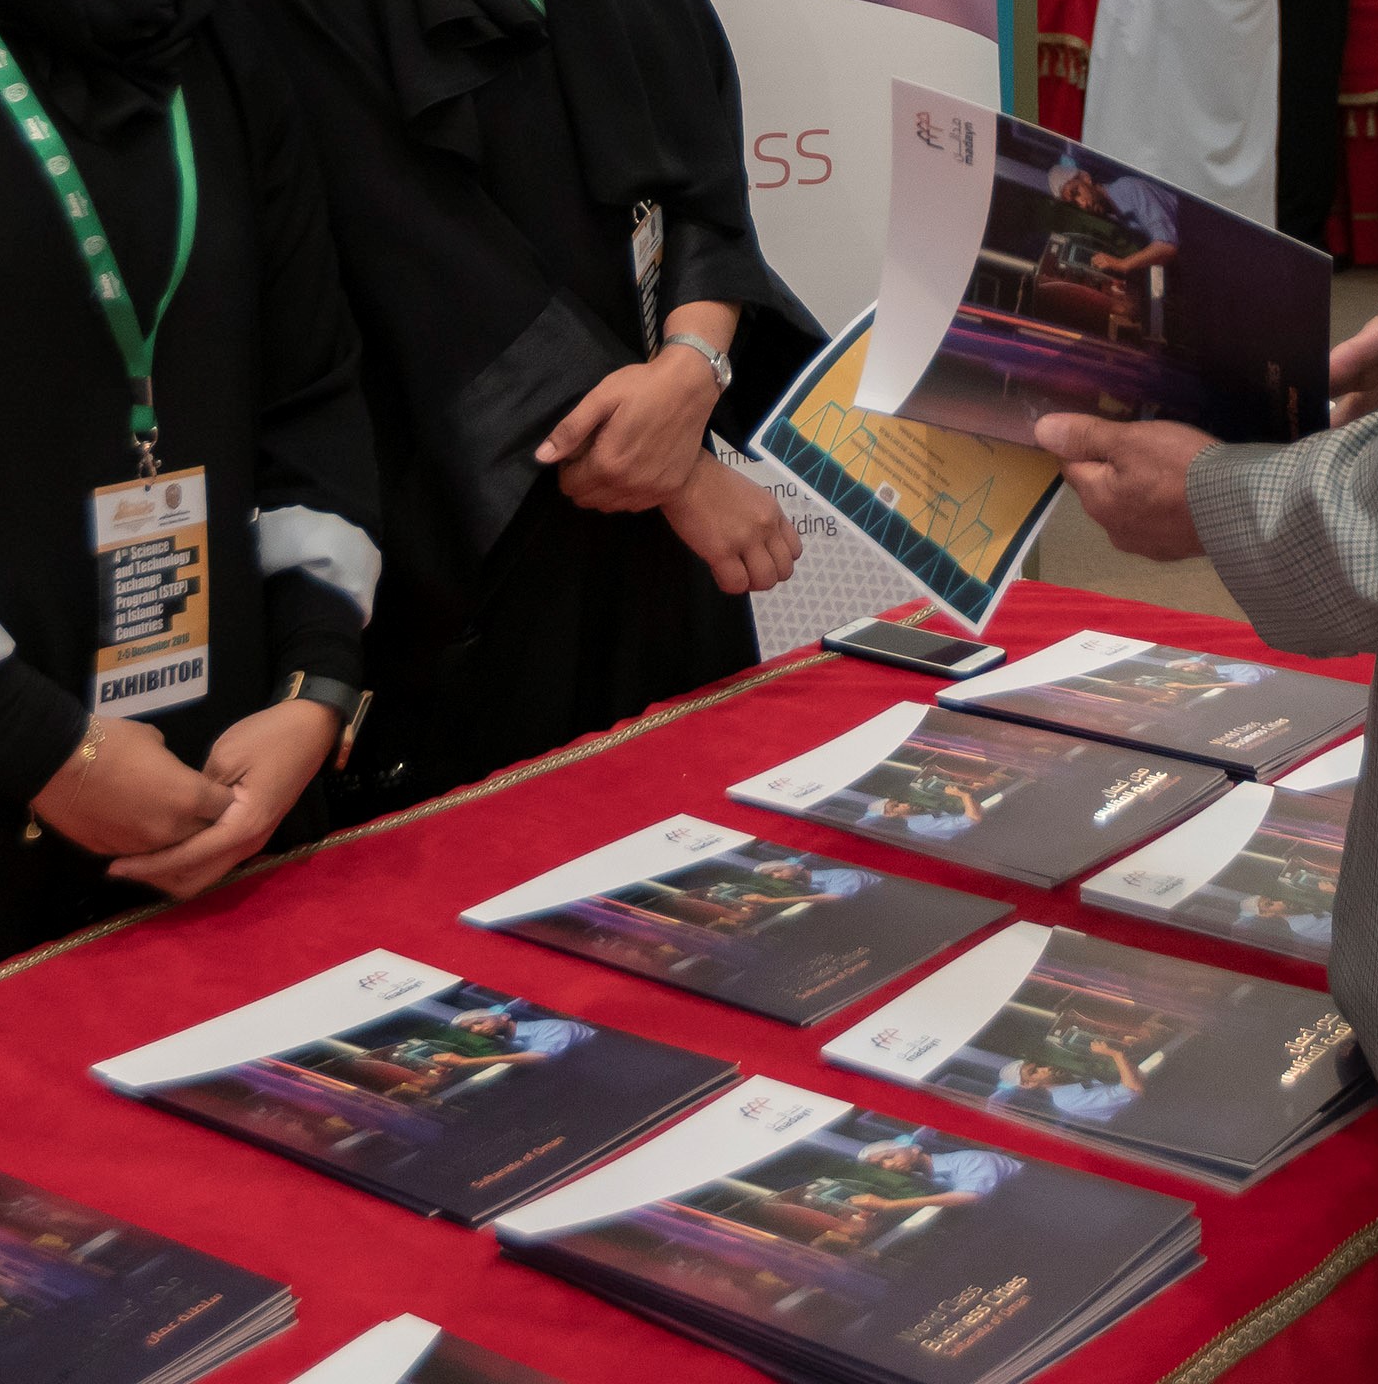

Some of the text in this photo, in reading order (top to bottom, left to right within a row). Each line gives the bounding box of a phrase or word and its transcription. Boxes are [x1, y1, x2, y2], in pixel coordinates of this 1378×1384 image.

[130, 540, 170, 560] Science
[114, 551, 191, 579] and Technology
[115, 572, 162, 595] Exchange
[115, 580, 189, 610] Program (STEP)
[115, 602, 164, 625] in Islamic
[115, 617, 164, 641] Countries
[131, 639, 171, 658] December
[100, 656, 204, 704] EXHIBITOR
[938, 1284, 983, 1313] Class
[920, 1275, 1028, 1352] Business Cities
